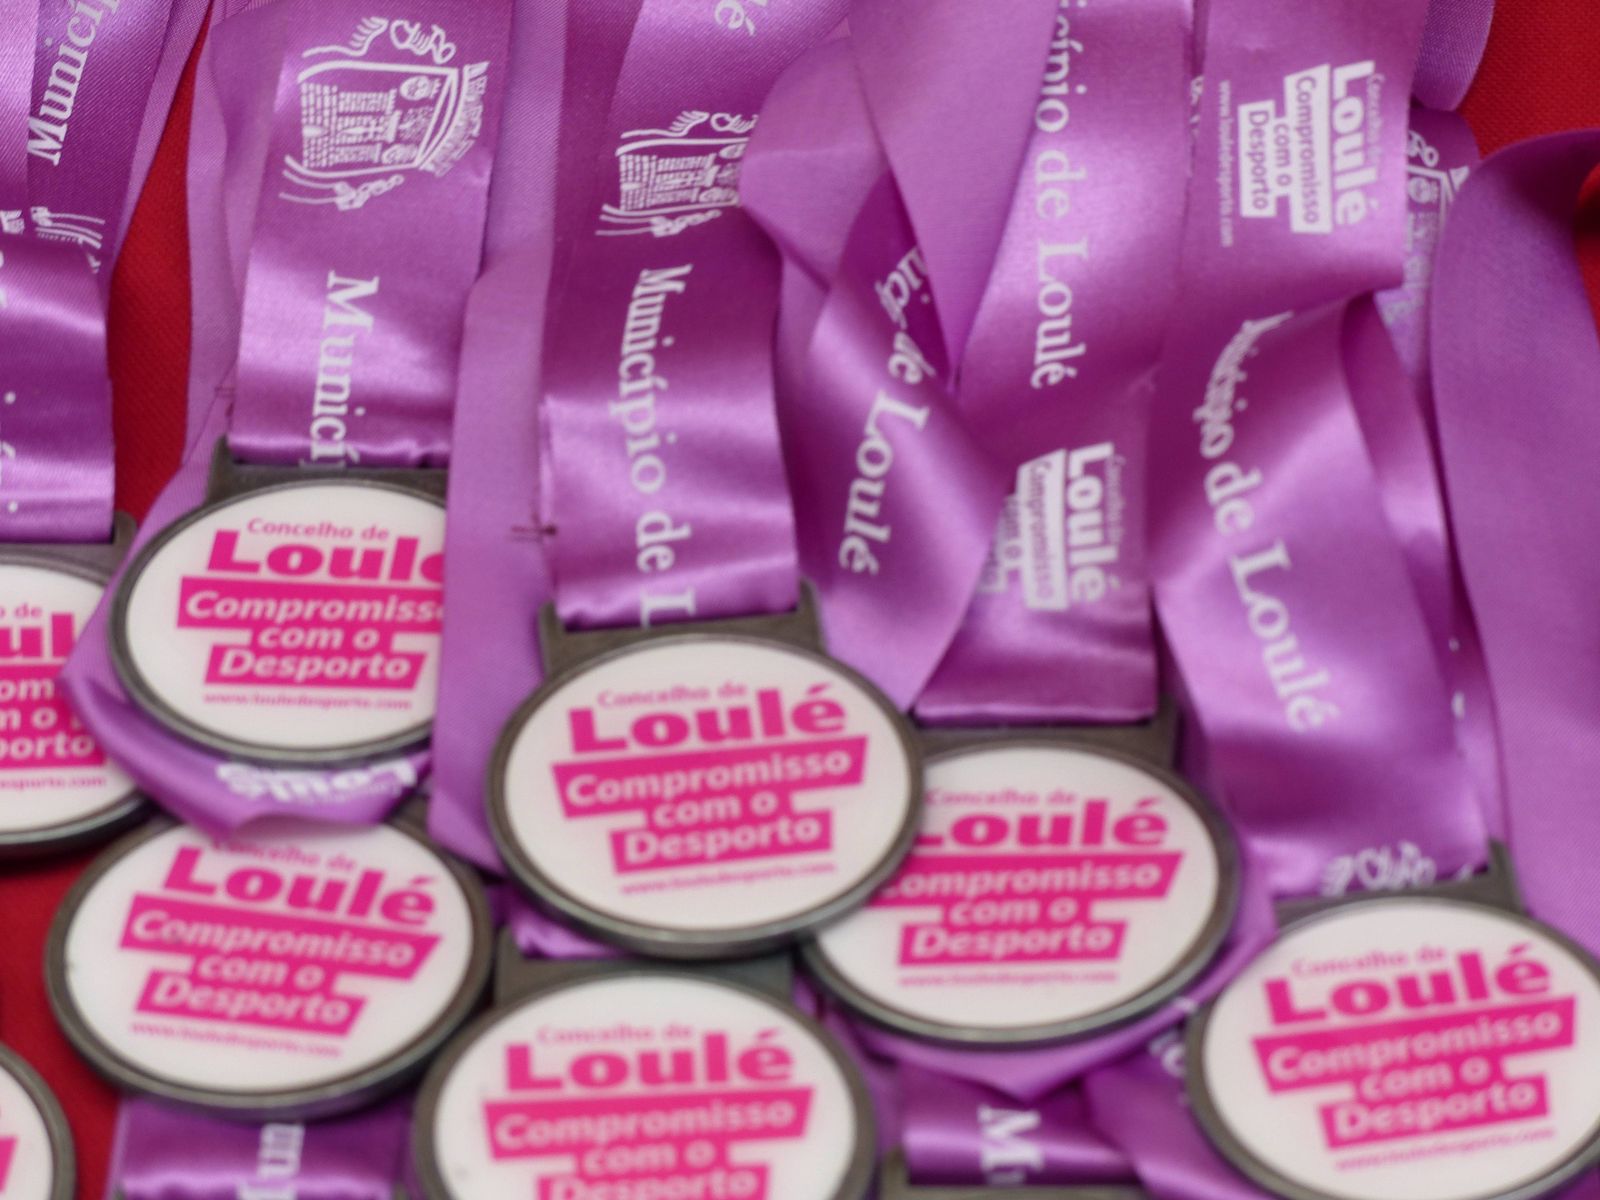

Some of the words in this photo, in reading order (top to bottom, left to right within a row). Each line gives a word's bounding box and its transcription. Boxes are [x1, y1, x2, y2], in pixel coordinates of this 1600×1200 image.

[1247, 110, 1270, 210] Desporto
[1273, 123, 1291, 168] com
[1295, 76, 1321, 224] Compromisso
[1333, 61, 1380, 225] Loulé
[1034, 149, 1087, 220] de
[1275, 173, 1292, 187] o
[1031, 238, 1088, 389] Loulé
[609, 263, 692, 496] Município
[838, 390, 928, 575] Loulé
[1202, 461, 1263, 536] de
[247, 518, 353, 540] Concelho
[361, 524, 390, 541] de
[635, 510, 691, 571] de
[1066, 441, 1120, 603] Loulé
[15, 603, 42, 618] de
[186, 590, 442, 624] Compromiss
[219, 648, 411, 683] Desporto
[258, 627, 344, 649] com
[353, 629, 380, 649] o
[1229, 539, 1342, 734] Loulé
[568, 683, 846, 754] Loulé
[566, 748, 852, 806] Compromisso
[653, 799, 741, 828] com
[751, 791, 778, 816] o
[624, 814, 821, 865] Desporto
[164, 846, 435, 926] Loulé
[949, 899, 1038, 925] com
[1049, 896, 1077, 922] o
[133, 909, 415, 967] Compromisso
[911, 924, 1114, 959] Desporto
[154, 974, 348, 1024] Desporto
[203, 955, 285, 987] com
[295, 963, 323, 988] o
[1264, 943, 1551, 1025] Loulé
[506, 1028, 792, 1091] Loulé
[1269, 1011, 1561, 1083] Compromisso
[1360, 1062, 1452, 1101] com
[1460, 1056, 1490, 1084] o
[496, 1095, 794, 1149] Compromisso
[1334, 1083, 1538, 1141] Desporto
[584, 1143, 675, 1175] com
[684, 1140, 714, 1165] o
